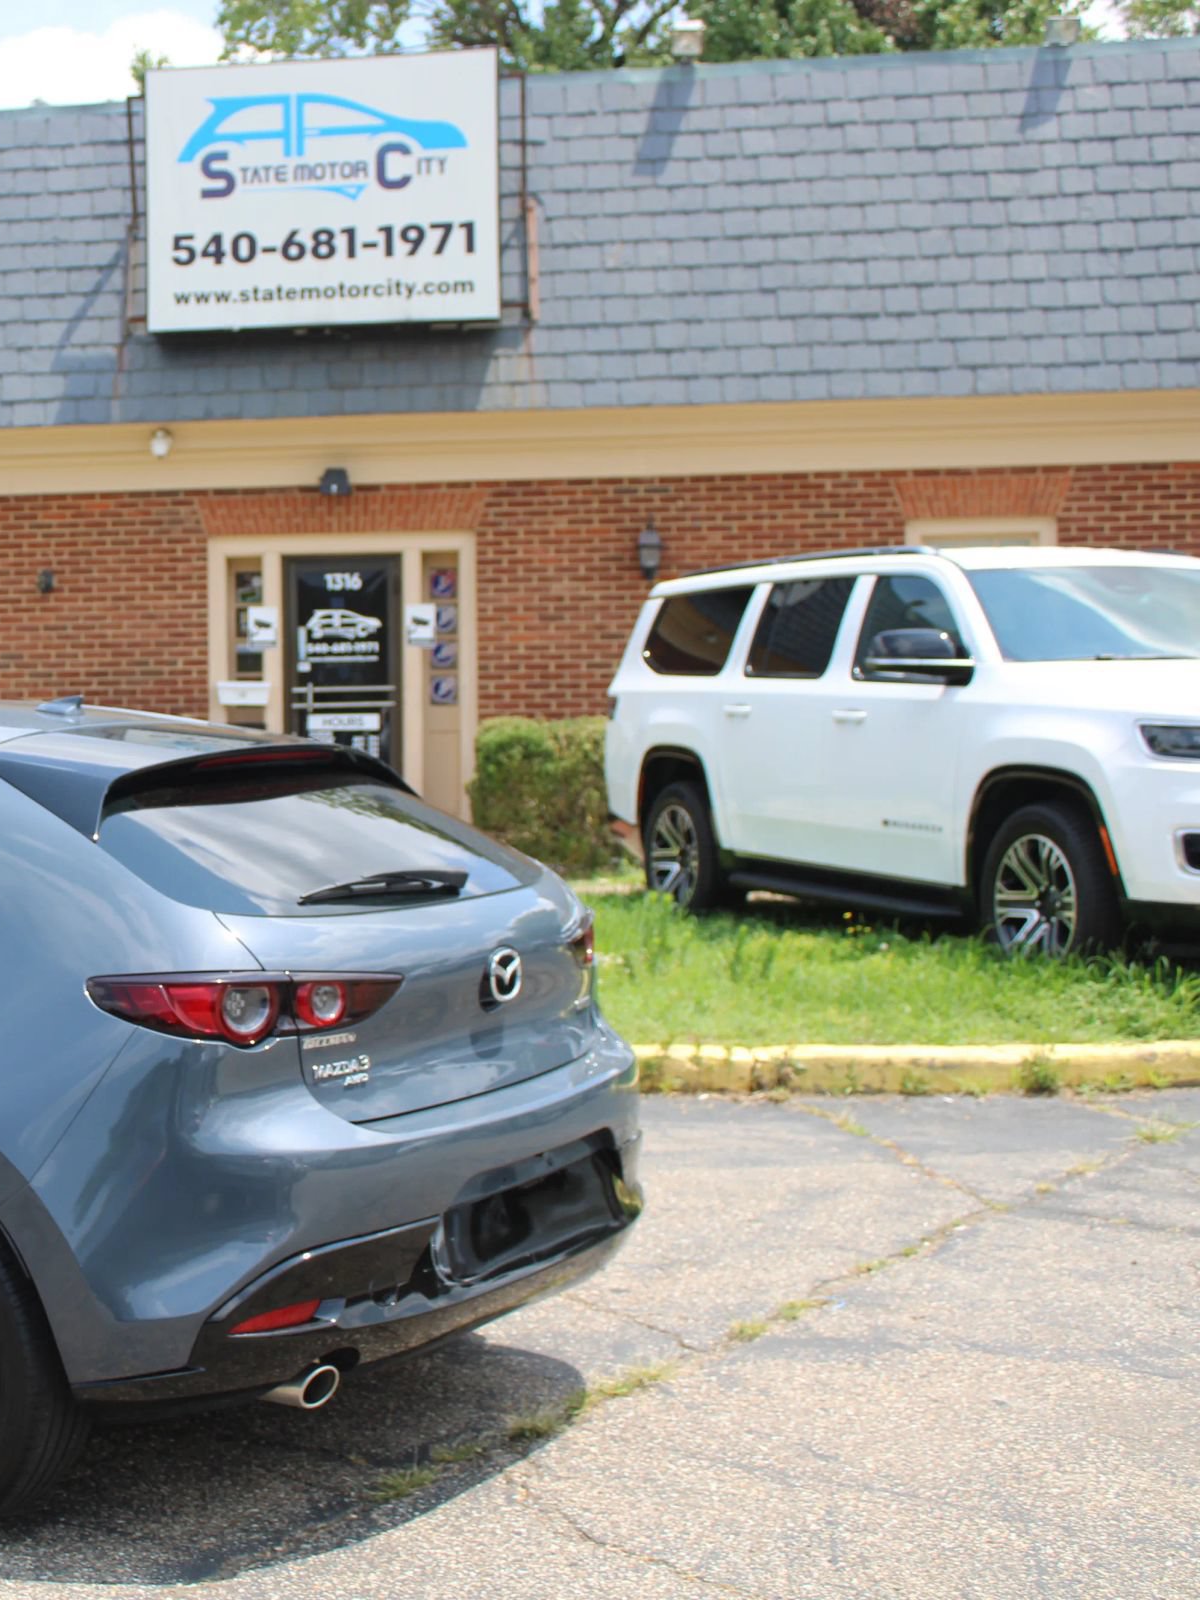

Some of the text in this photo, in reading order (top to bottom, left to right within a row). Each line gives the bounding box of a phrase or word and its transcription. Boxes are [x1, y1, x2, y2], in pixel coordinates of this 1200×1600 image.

[201, 142, 448, 199] STATE MOTOR CITY
[172, 220, 476, 266] 540-681-1971
[174, 278, 475, 305] www.statemotorcity.com
[323, 572, 362, 591] 1316
[322, 716, 364, 727] HOURS
